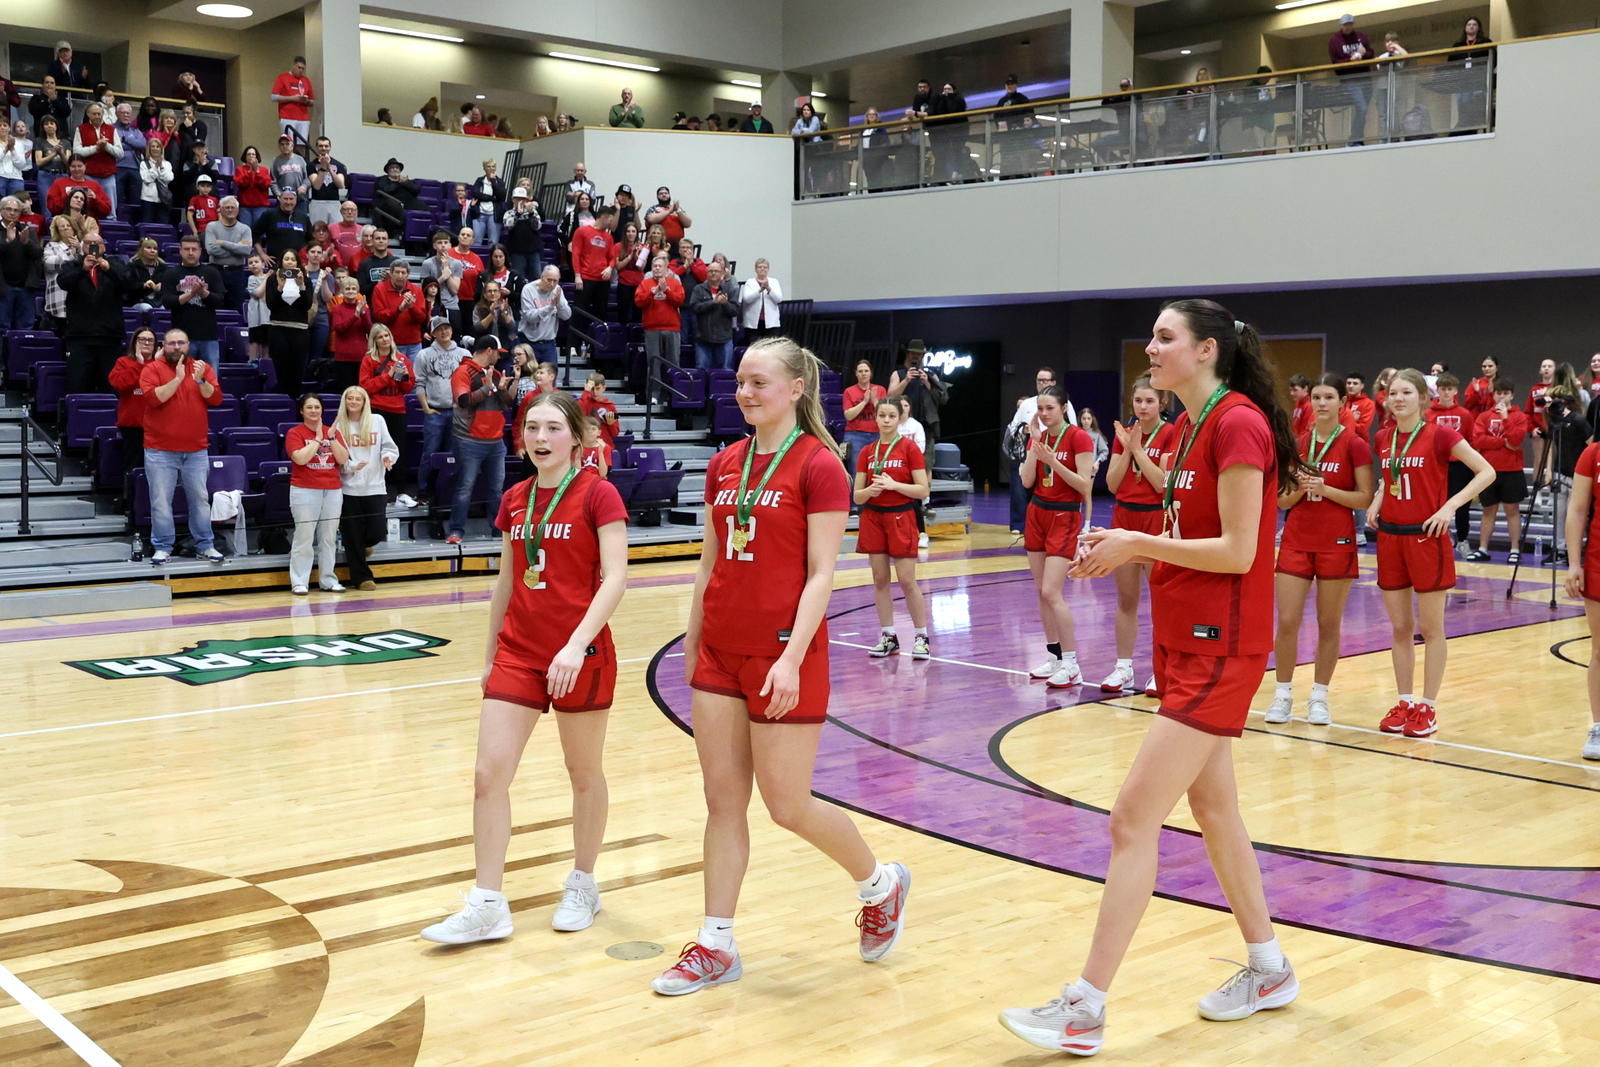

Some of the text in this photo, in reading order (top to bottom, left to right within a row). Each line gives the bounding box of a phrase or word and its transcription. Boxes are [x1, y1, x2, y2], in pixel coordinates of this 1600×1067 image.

[196, 209, 206, 219] 20
[726, 515, 757, 562] 12
[94, 633, 430, 676] OHSAA
